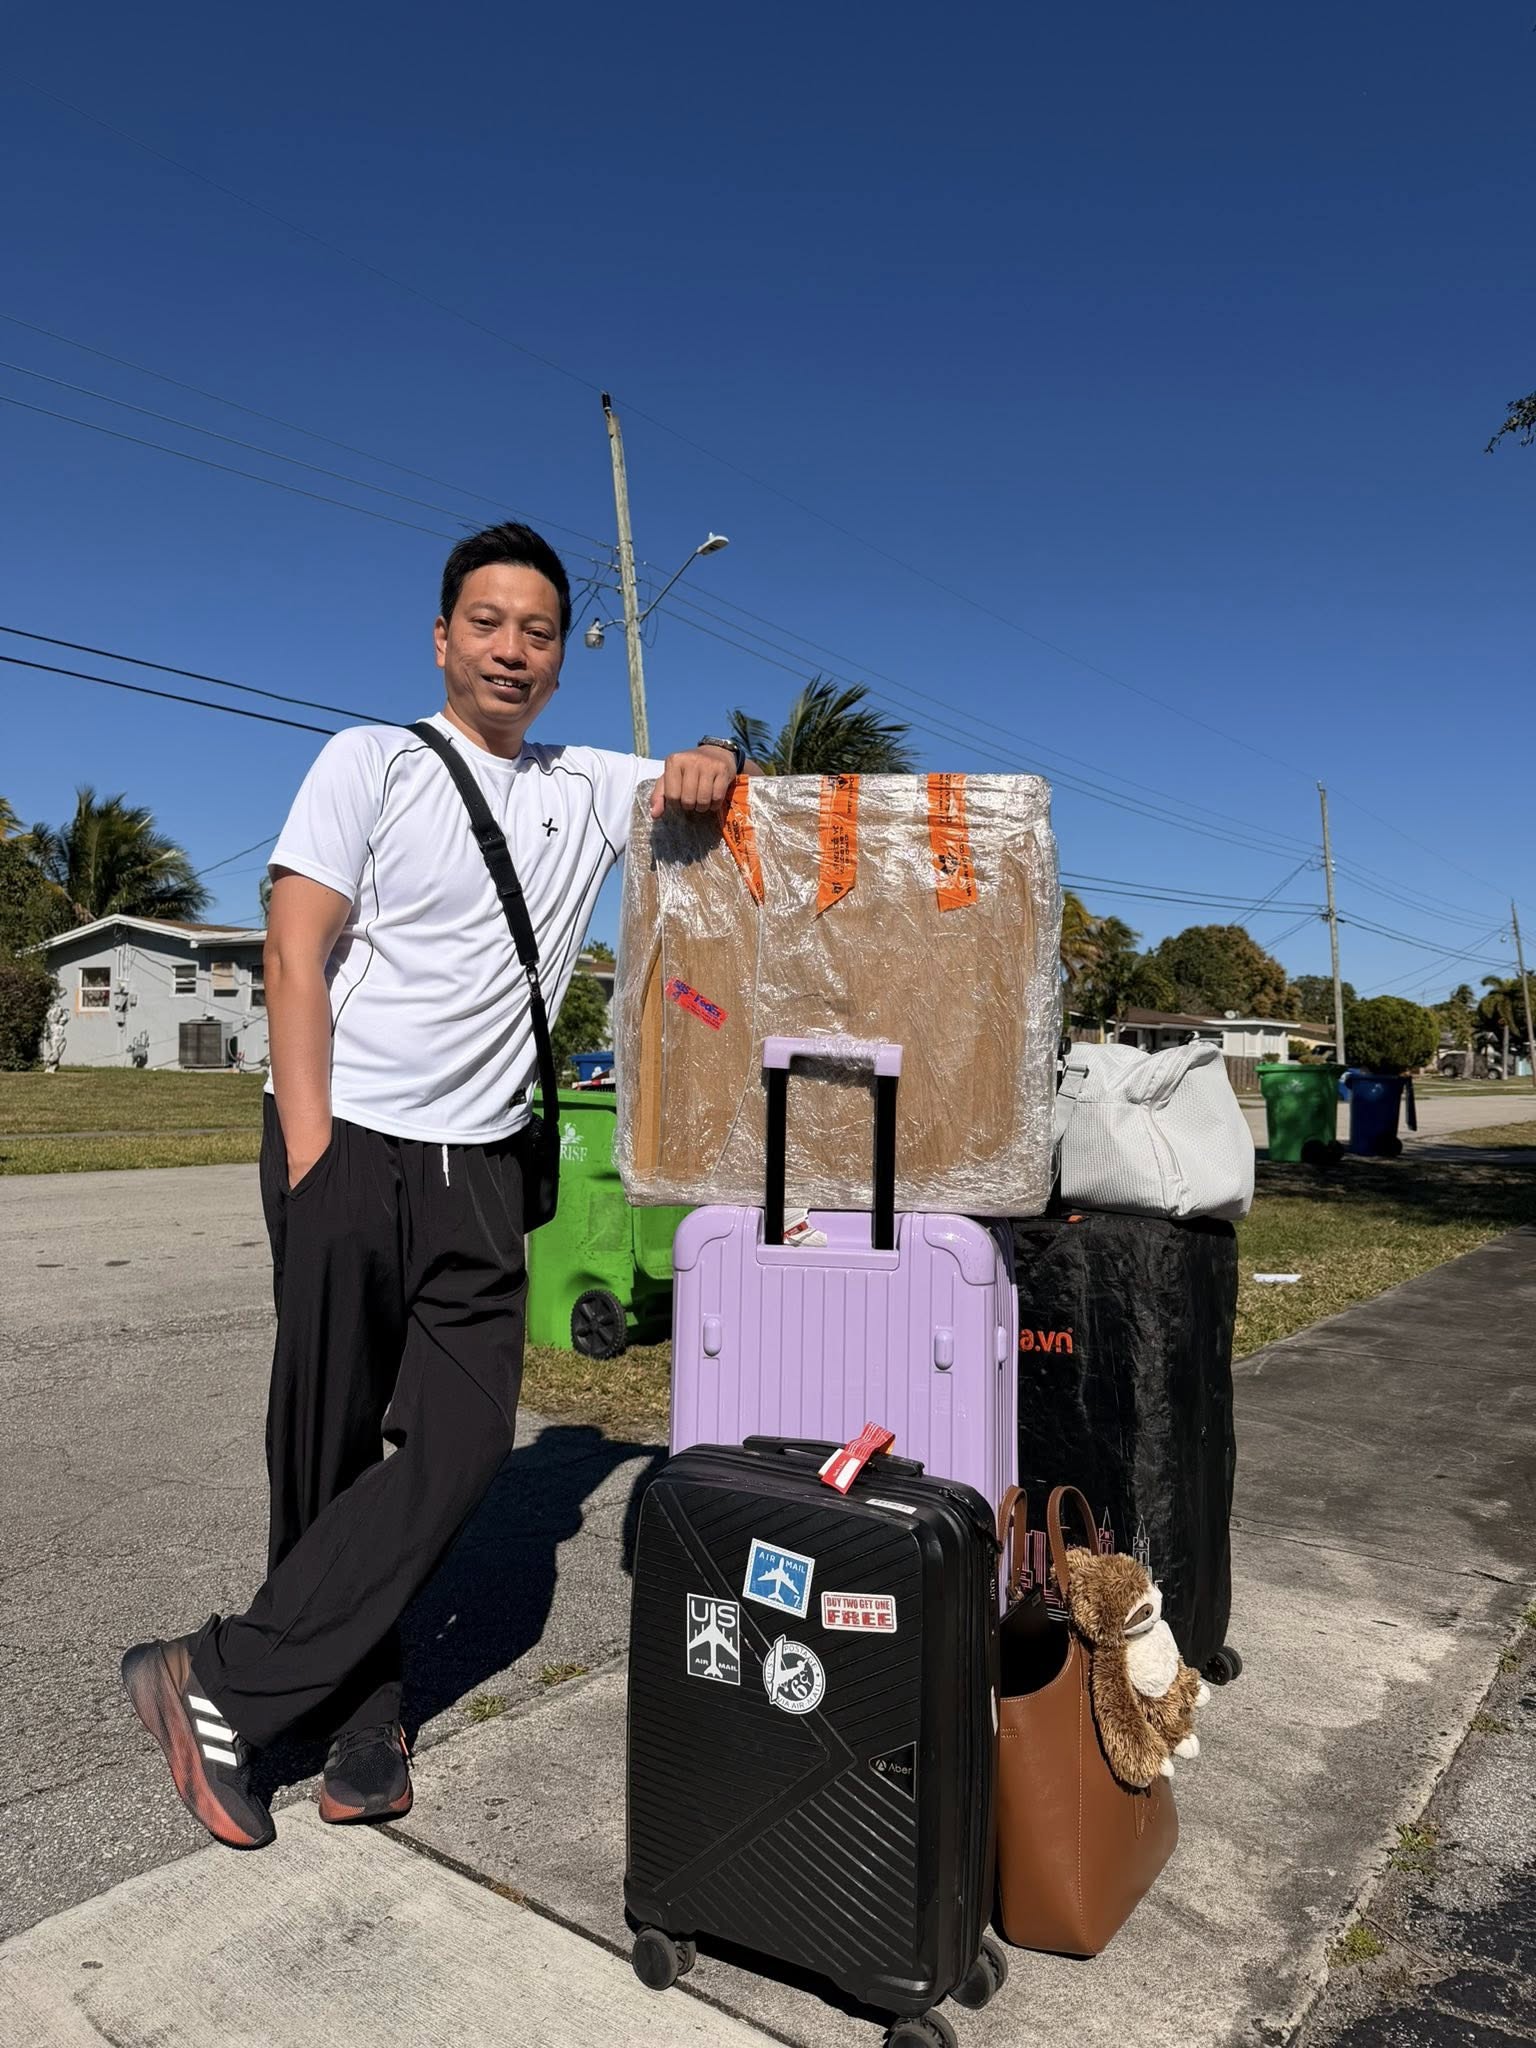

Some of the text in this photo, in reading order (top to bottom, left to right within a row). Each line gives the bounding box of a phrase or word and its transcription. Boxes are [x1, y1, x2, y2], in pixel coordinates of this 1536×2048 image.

[759, 1551, 805, 1574] AIR MAIL
[826, 1597, 890, 1610] BUY TWO GET ONE
[827, 1609, 892, 1627] FREE
[695, 1657, 738, 1672] AIR MAIL
[784, 1645, 817, 1668] POSTAGE
[806, 1683, 821, 1706] MAIL
